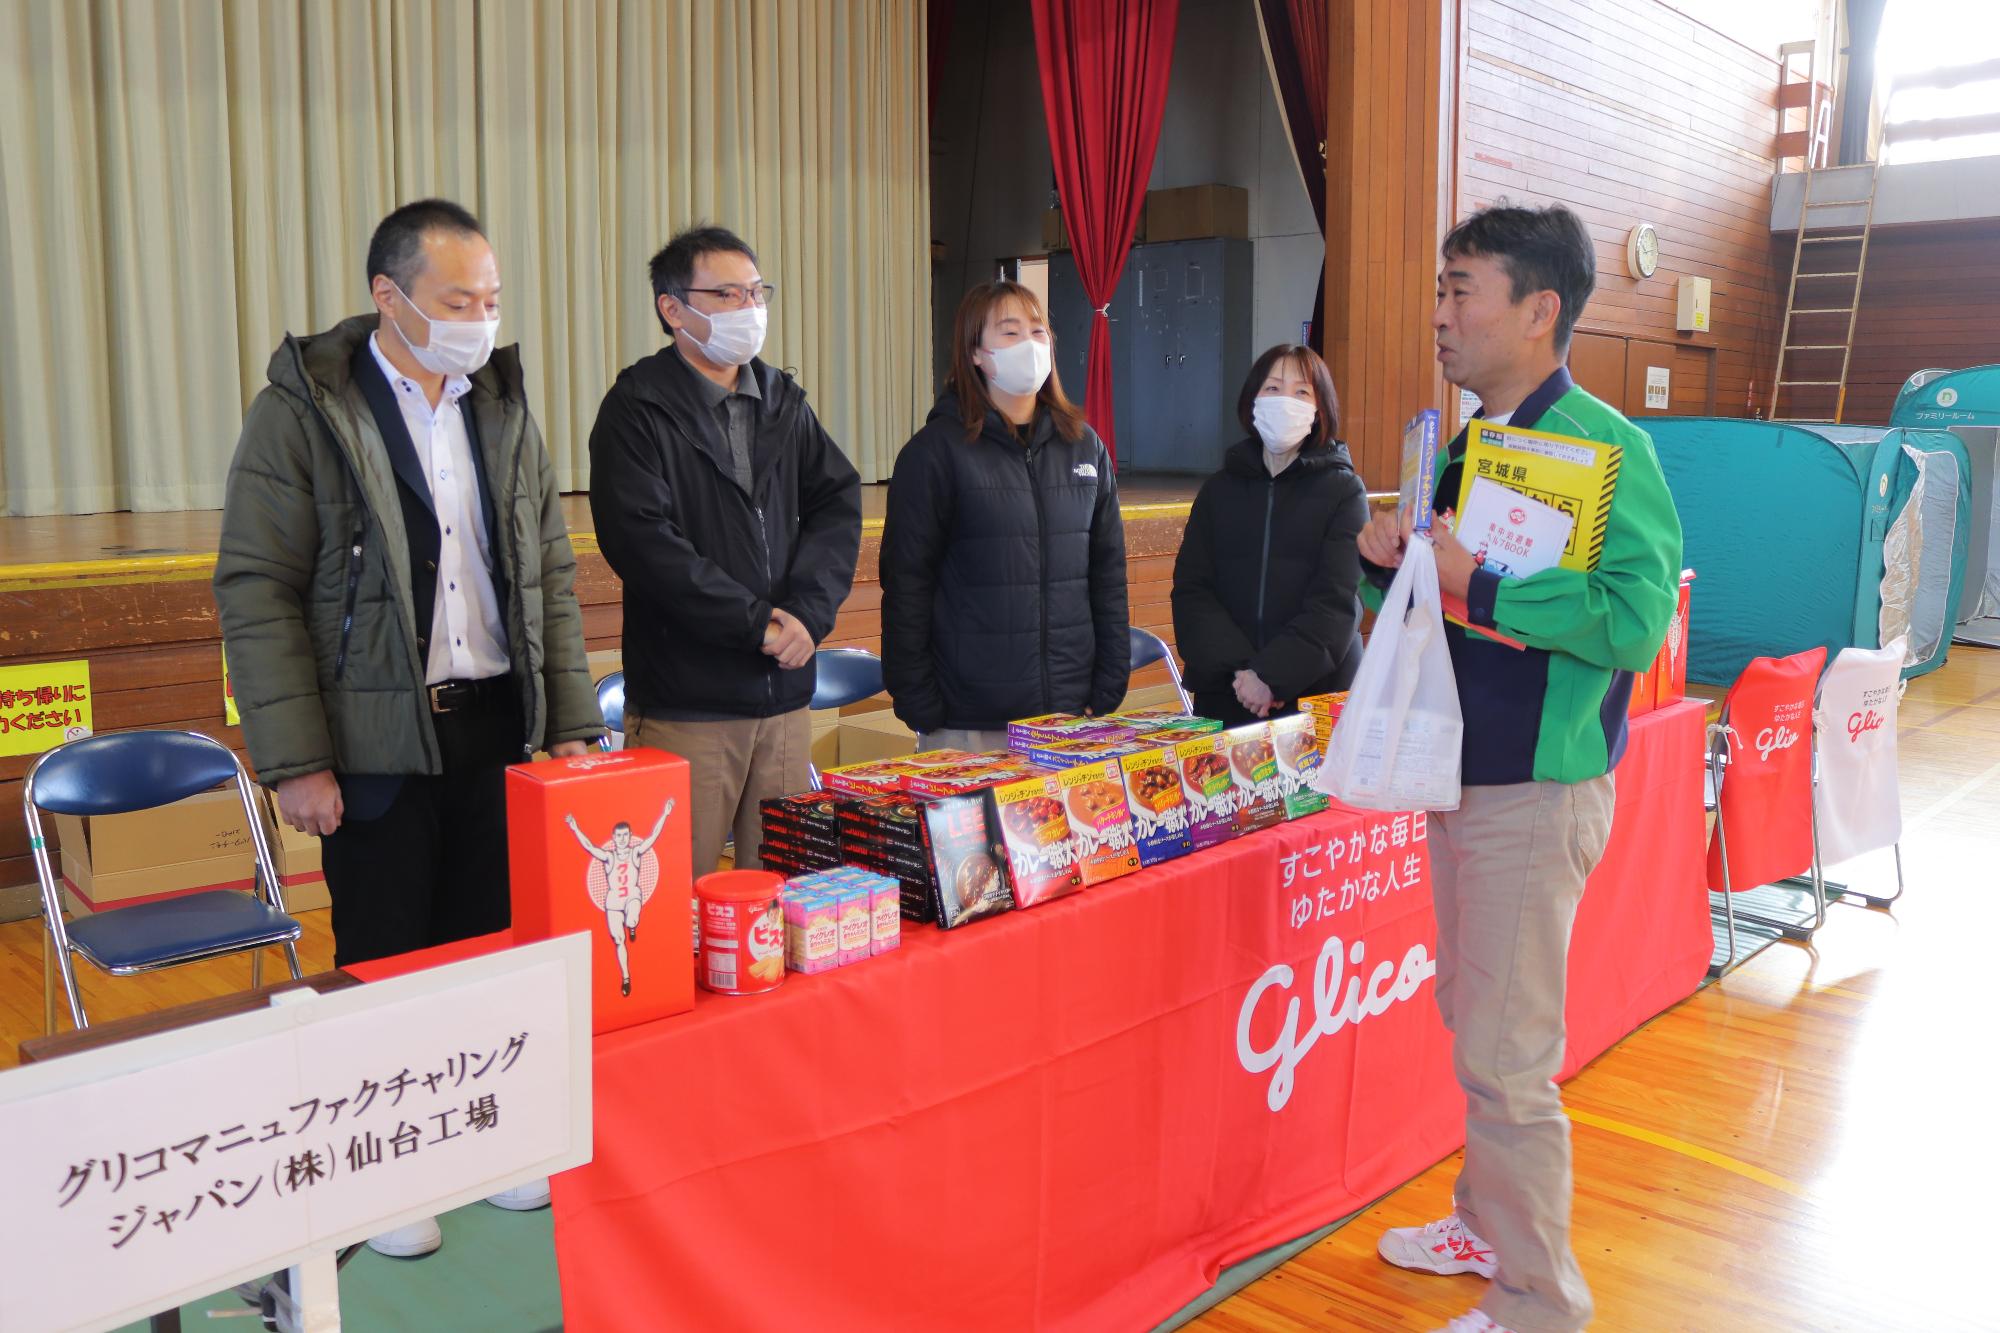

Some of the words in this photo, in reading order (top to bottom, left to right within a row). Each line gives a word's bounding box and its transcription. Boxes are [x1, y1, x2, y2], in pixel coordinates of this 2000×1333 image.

[1916, 411, 1975, 420] ファミリールーム
[1478, 459, 1527, 482] 宮城県
[1133, 802, 1189, 845] カレー職人
[1187, 787, 1239, 825] カレー職人
[1011, 834, 1079, 881] カレー職人
[1073, 817, 1136, 861] カレー職人
[1279, 811, 1428, 888] すこやかな毎日
[1290, 852, 1422, 929] ゆたかな人生
[1236, 935, 1436, 1112] Glico
[58, 1031, 529, 1209] グリコマニュファクチャリング
